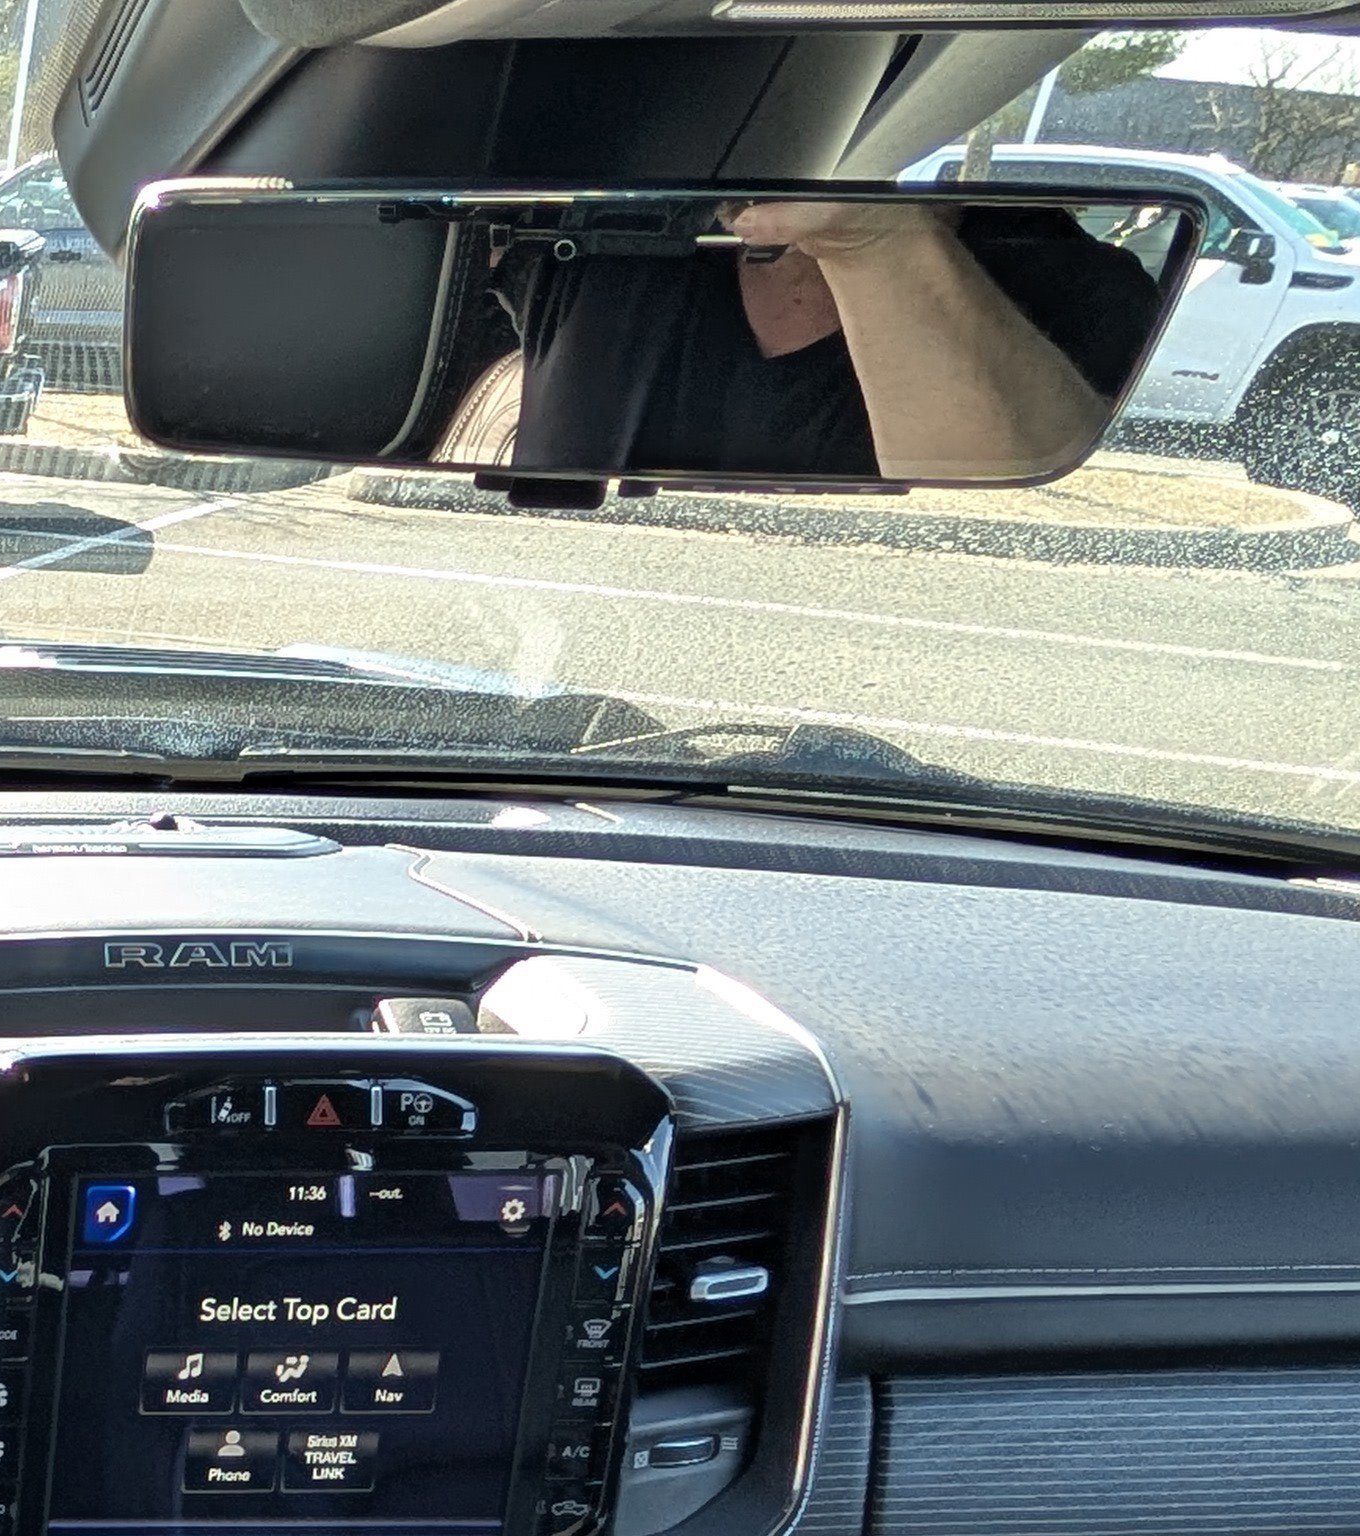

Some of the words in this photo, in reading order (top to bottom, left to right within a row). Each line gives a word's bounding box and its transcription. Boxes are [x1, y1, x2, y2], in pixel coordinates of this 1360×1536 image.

[104, 942, 294, 968] RAM
[232, 1112, 251, 1123] OFF
[288, 1186, 327, 1201] 11:36
[242, 1221, 263, 1236] No
[266, 1221, 314, 1236] Device
[200, 1296, 277, 1321] Select
[282, 1297, 330, 1325] Top
[336, 1296, 398, 1321] Card
[576, 1339, 610, 1348] FRONT
[166, 1389, 209, 1403] Media
[260, 1389, 317, 1403] Comfort
[375, 1389, 403, 1402] Nav
[306, 1435, 337, 1448] Sirius
[339, 1435, 358, 1448] XM
[304, 1451, 356, 1464] TRAVEL
[562, 1445, 591, 1458] A/C
[207, 1468, 251, 1482] Phone
[312, 1467, 345, 1480] LINK
